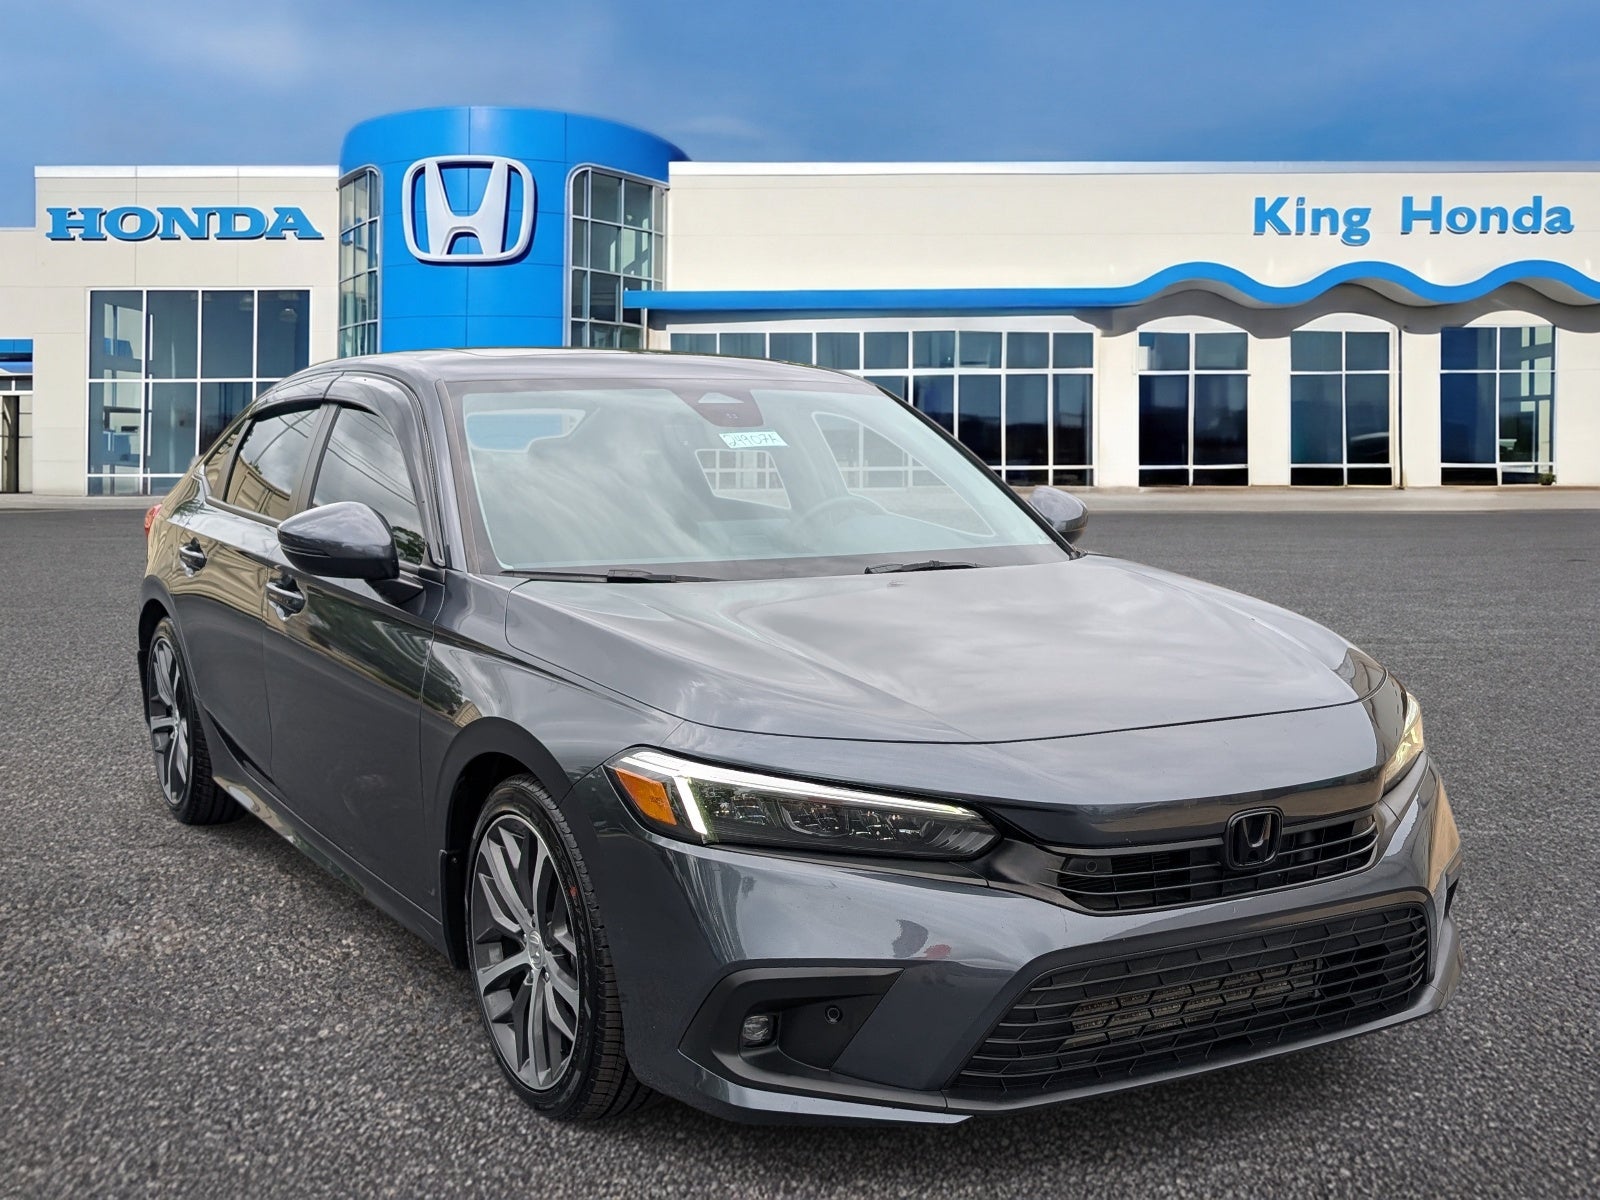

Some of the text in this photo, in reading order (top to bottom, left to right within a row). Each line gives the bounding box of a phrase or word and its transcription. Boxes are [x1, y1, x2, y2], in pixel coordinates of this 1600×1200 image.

[45, 206, 324, 242] HONDA
[1253, 195, 1575, 247] King Honda
